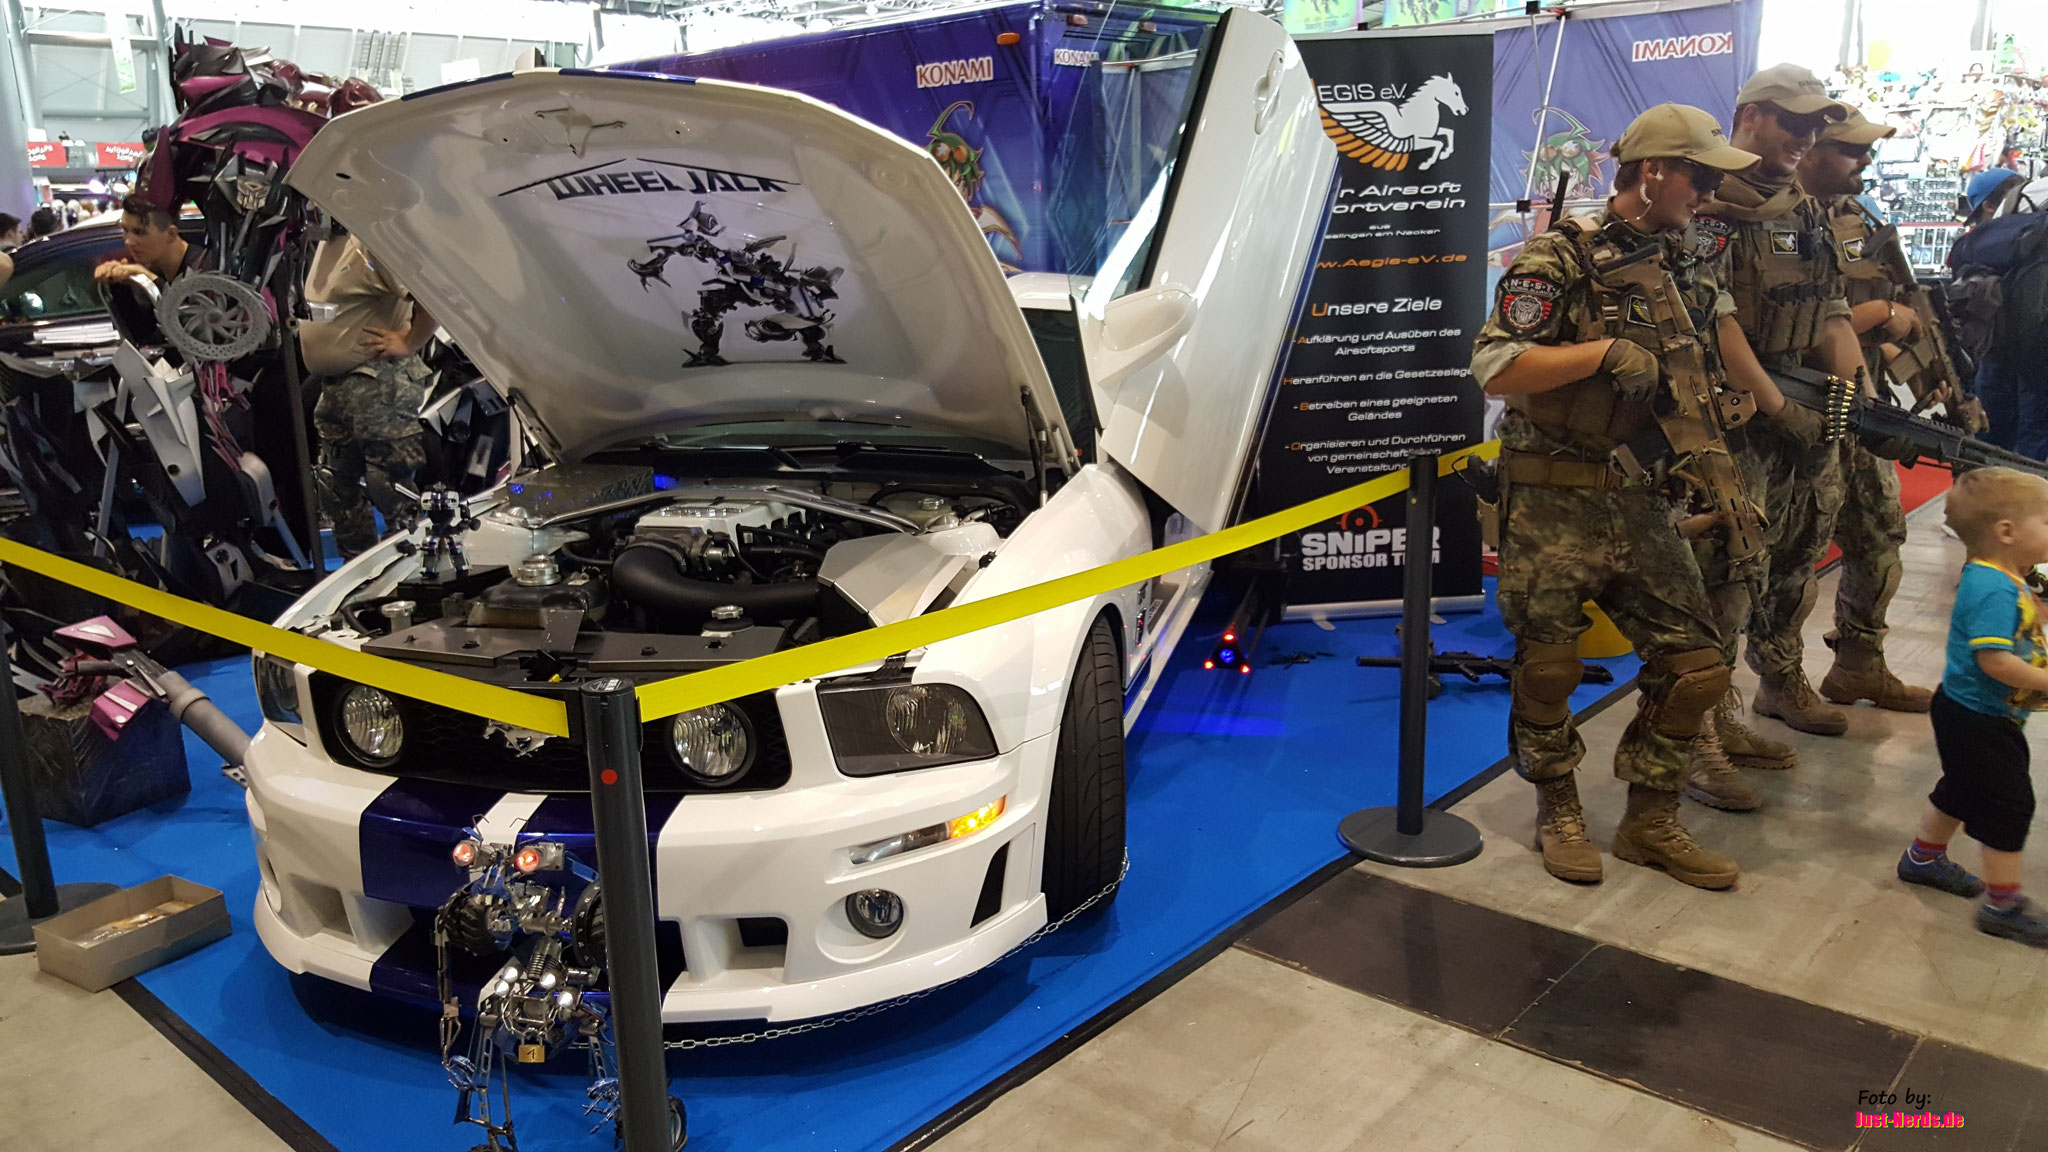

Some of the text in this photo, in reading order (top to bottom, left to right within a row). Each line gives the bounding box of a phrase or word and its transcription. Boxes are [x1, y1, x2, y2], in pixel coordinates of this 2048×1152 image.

[917, 56, 994, 88] KONAMI
[1312, 79, 1376, 102] EGIS
[540, 168, 788, 201] WHEEL JACK
[1358, 181, 1462, 198] Airsoft
[1332, 197, 1466, 214] ortverein
[1324, 231, 1373, 240] sslingen
[1396, 228, 1441, 237] Neckar
[1368, 223, 1391, 231] aus
[1312, 297, 1442, 317] Unsere Ziele
[1297, 328, 1462, 345] Aufklärung und Ausüben des
[1334, 344, 1416, 356] Airsoftsports
[1283, 374, 1357, 386] Heranführen
[1358, 373, 1373, 383] an
[1375, 371, 1393, 381] die
[1300, 394, 1458, 411] Betreiben eines geeigneten
[1347, 410, 1403, 422] Geländes
[1291, 433, 1466, 452] Organisieren und Durchführen
[1308, 453, 1328, 463] von
[1302, 552, 1388, 571] SPONSOR
